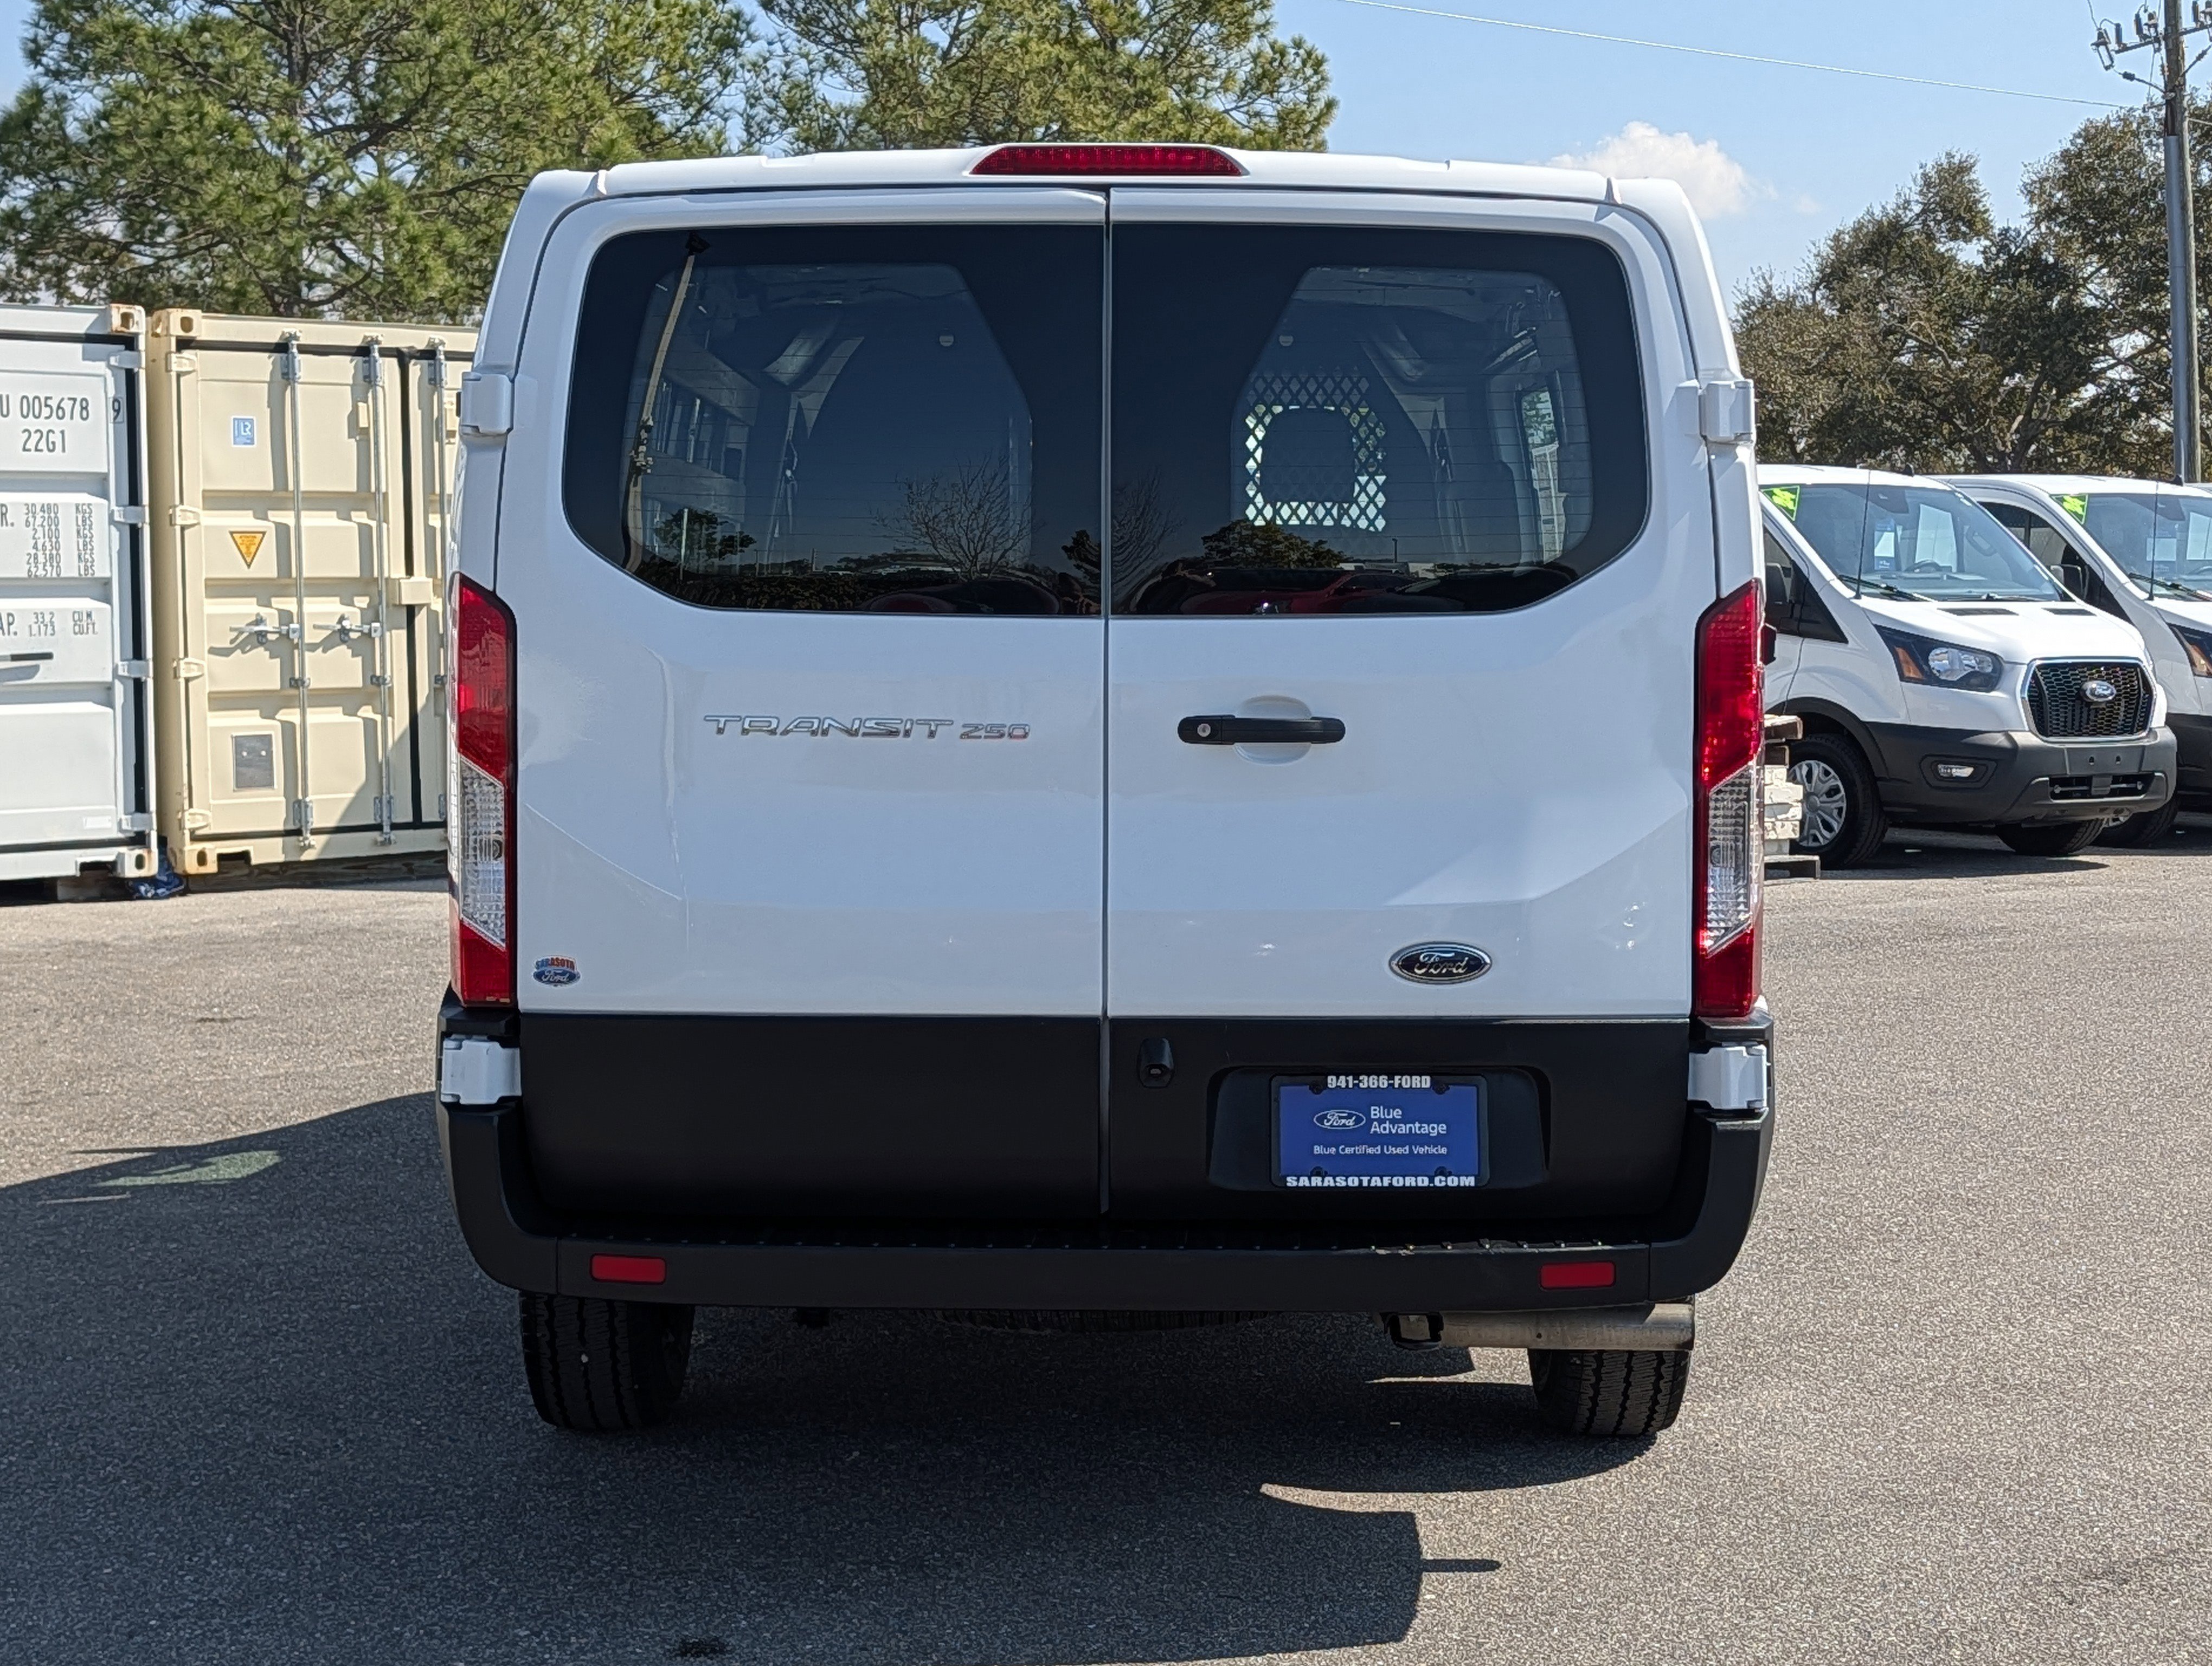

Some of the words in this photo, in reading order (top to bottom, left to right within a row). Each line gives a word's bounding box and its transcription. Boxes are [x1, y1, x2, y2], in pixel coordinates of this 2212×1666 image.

[20, 395, 89, 421] 005678
[112, 398, 121, 421] 9
[22, 428, 66, 453] 22G1
[75, 503, 93, 514] KGS
[76, 515, 93, 527] LBS
[76, 527, 94, 539] KGS
[77, 540, 94, 552] LBS
[78, 552, 95, 564] KGS
[78, 565, 95, 576] LBS
[704, 715, 954, 738] TRANSIT
[960, 723, 1030, 739] 250
[1414, 952, 1469, 974] Ford
[542, 970, 569, 982] Ford
[1327, 1075, 1431, 1088] 941-366-FORD
[1371, 1106, 1402, 1119] Blue
[1324, 1112, 1356, 1126] Ford
[1369, 1120, 1447, 1136] Advantage
[1313, 1145, 1336, 1155] Blue
[1339, 1145, 1381, 1155] Certified
[1384, 1145, 1409, 1154] Used
[1412, 1145, 1447, 1155] Vehicle
[1286, 1176, 1475, 1187] SARASOTAFORD.COM
